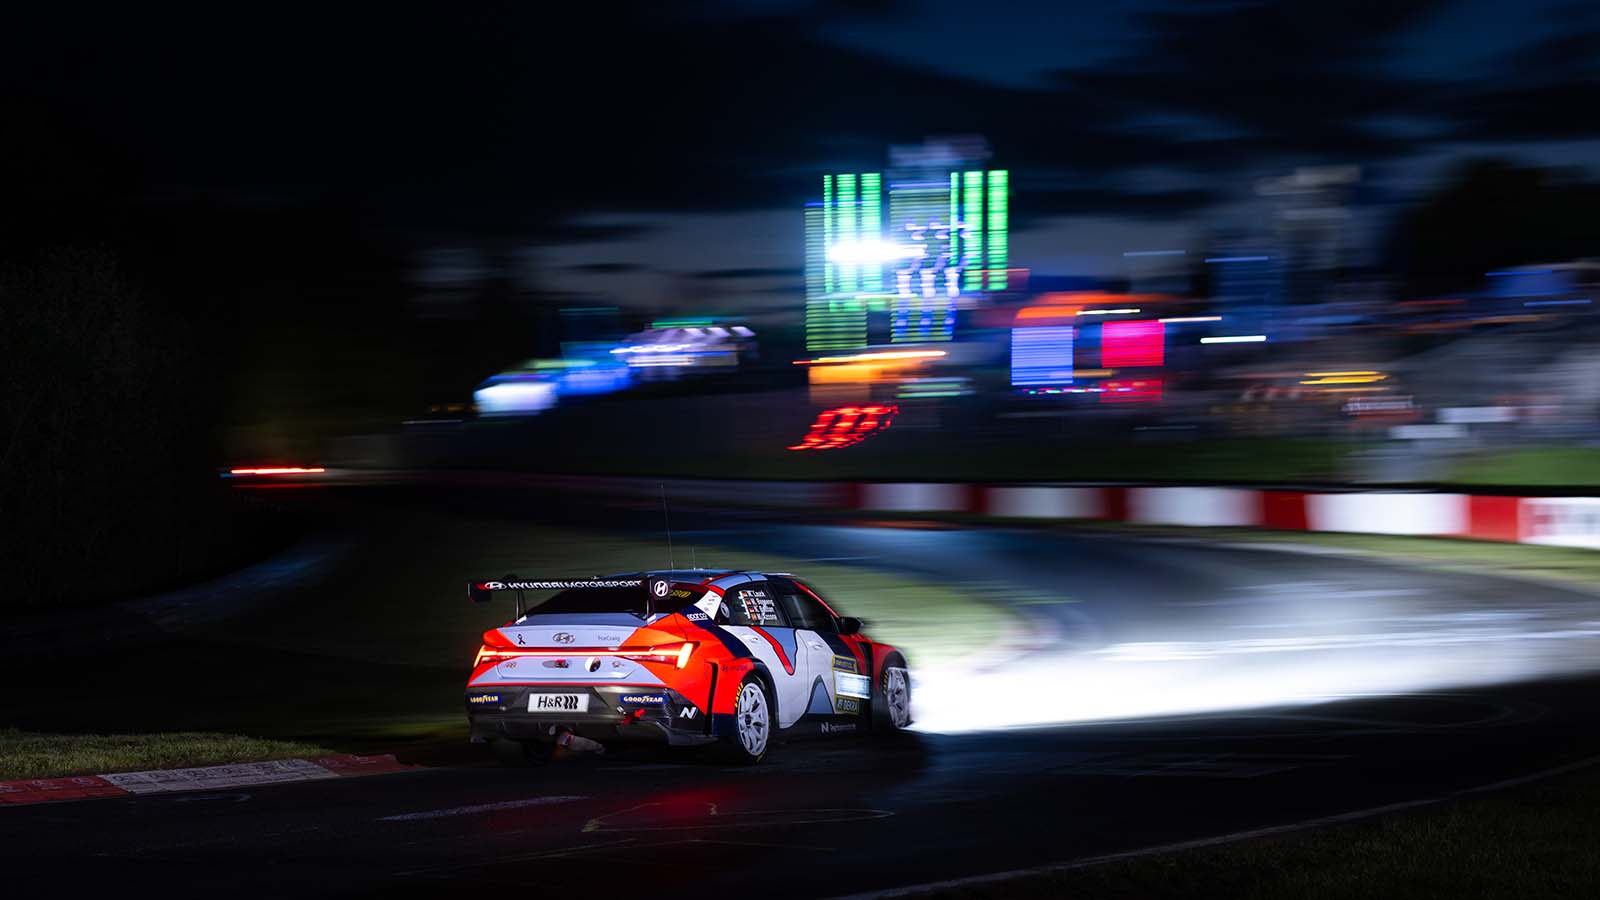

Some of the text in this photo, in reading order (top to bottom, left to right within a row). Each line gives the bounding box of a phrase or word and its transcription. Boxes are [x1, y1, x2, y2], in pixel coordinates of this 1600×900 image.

[565, 579, 643, 589] MOTORSPORT
[470, 694, 499, 704] GOODYEAR
[538, 695, 563, 709] H&R
[623, 694, 664, 705] GOODYEAR
